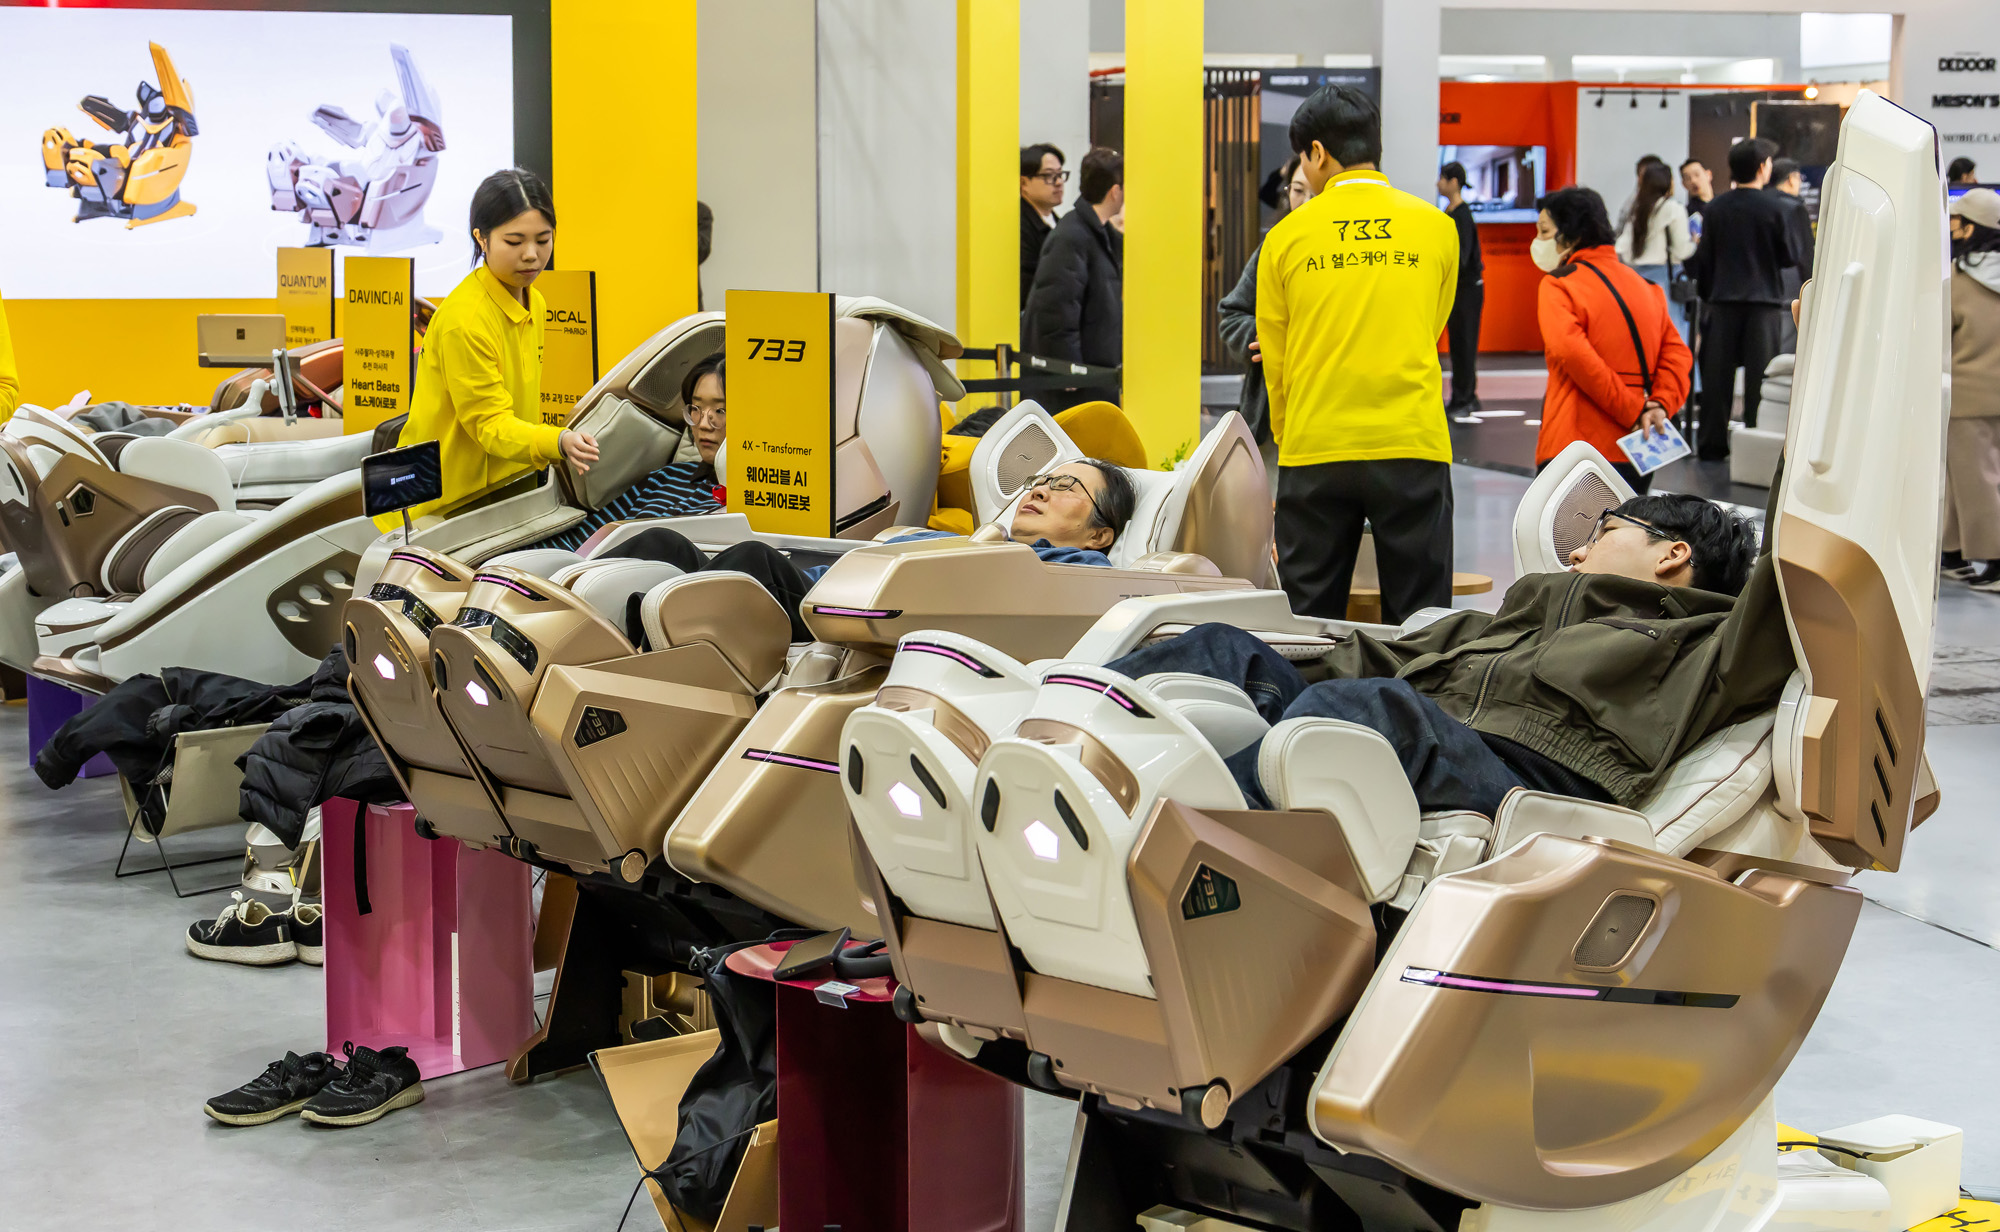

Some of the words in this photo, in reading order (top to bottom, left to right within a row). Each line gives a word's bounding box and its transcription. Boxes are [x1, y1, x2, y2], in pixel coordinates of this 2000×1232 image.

[1938, 58, 1996, 72] DEDOOR
[1332, 218, 1392, 242] 733
[1306, 255, 1326, 273] AI
[1331, 250, 1388, 269] 헬스케어
[1393, 250, 1420, 268] 로봇
[280, 274, 327, 288] QUANTUM
[747, 337, 807, 363] 733
[351, 378, 375, 391] Heart
[376, 380, 400, 393] Beats
[552, 393, 563, 404] 교정
[564, 394, 575, 404] 모드
[742, 439, 754, 452] 4X
[761, 441, 813, 456] Transformer
[746, 465, 791, 486] 웨어러블
[793, 470, 808, 487] AI
[743, 489, 811, 512] 헬스케어로봇
[587, 708, 607, 737] 733
[1201, 869, 1218, 910] 733
